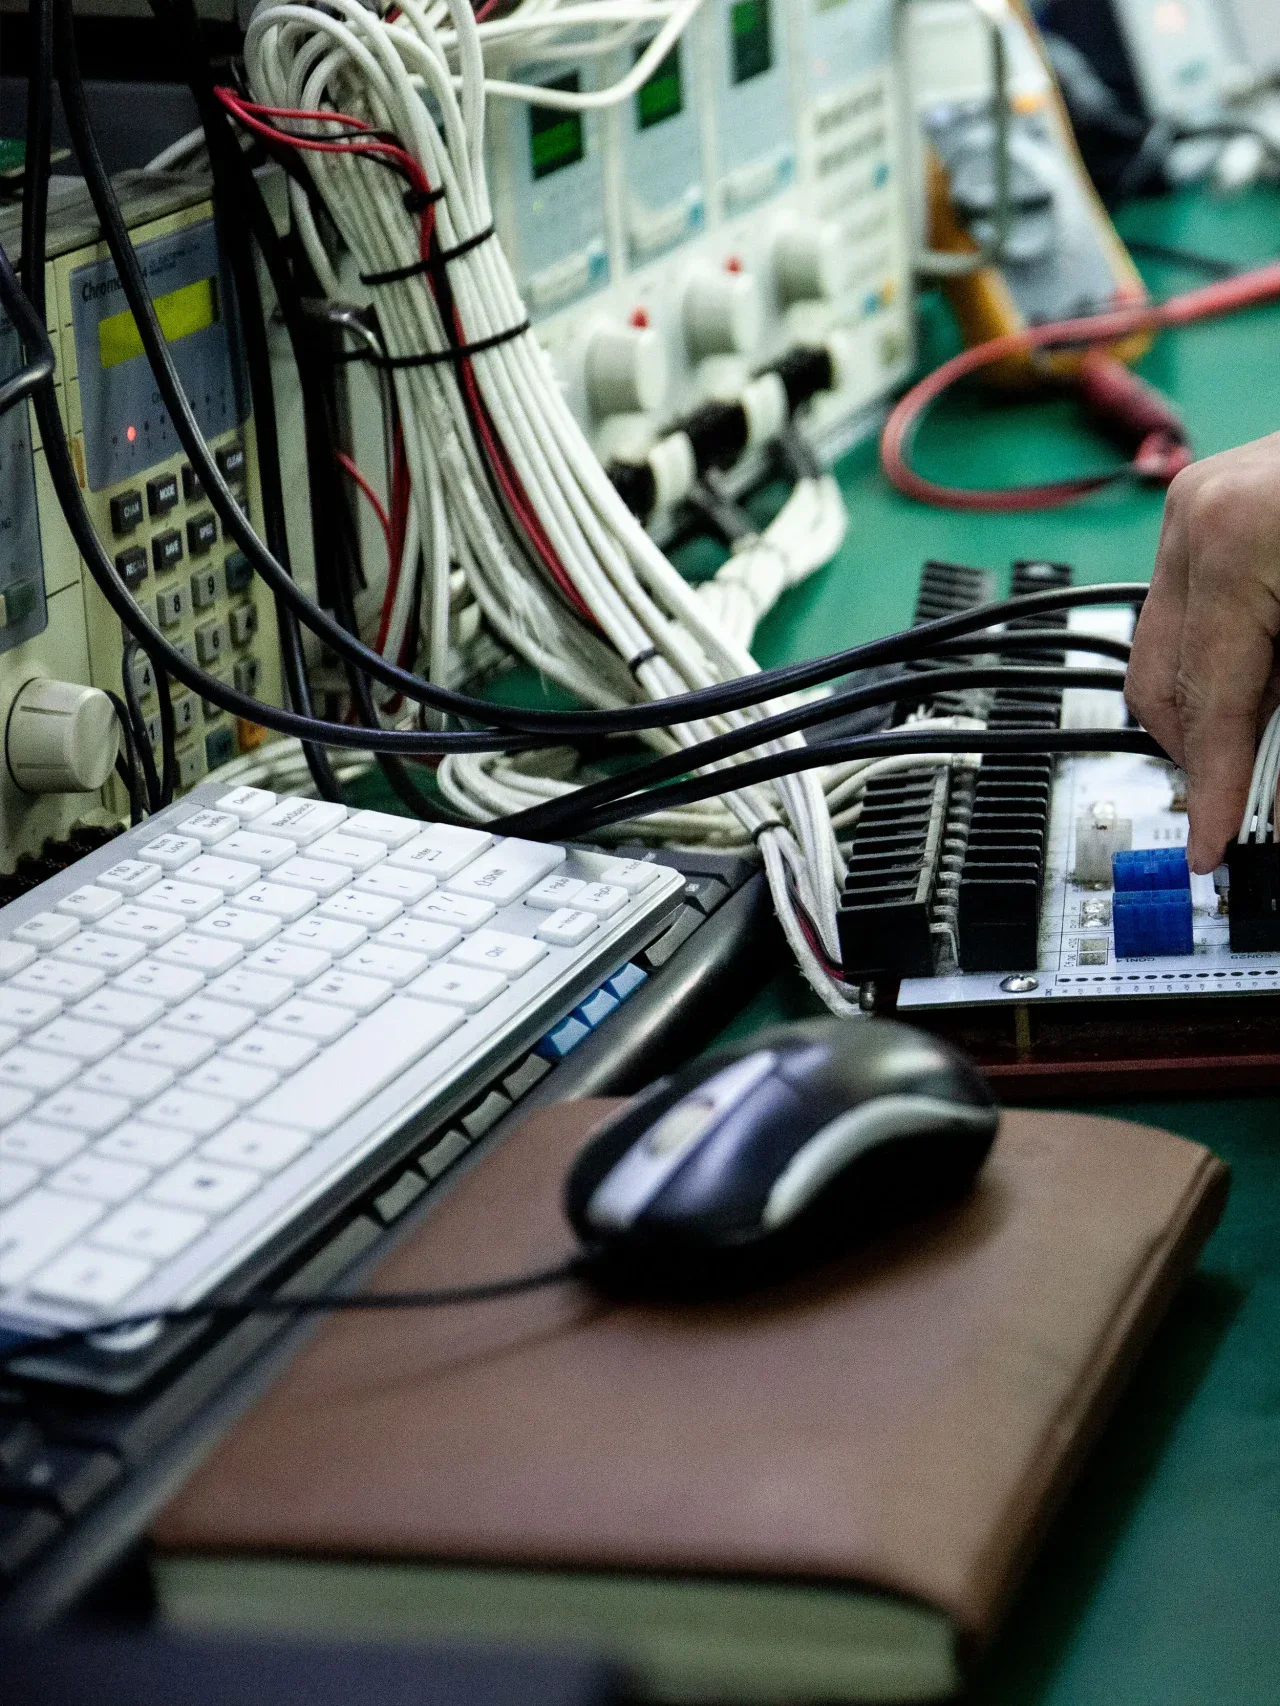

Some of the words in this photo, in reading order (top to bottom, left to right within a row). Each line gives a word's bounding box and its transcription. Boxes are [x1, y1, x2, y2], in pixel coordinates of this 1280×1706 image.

[207, 576, 215, 595] 9
[173, 593, 181, 613] 8
[212, 630, 220, 648] 6
[143, 669, 151, 686] 4
[183, 702, 191, 722] 2
[151, 838, 173, 850] Num
[164, 840, 189, 854] Lock
[107, 866, 130, 877] F10
